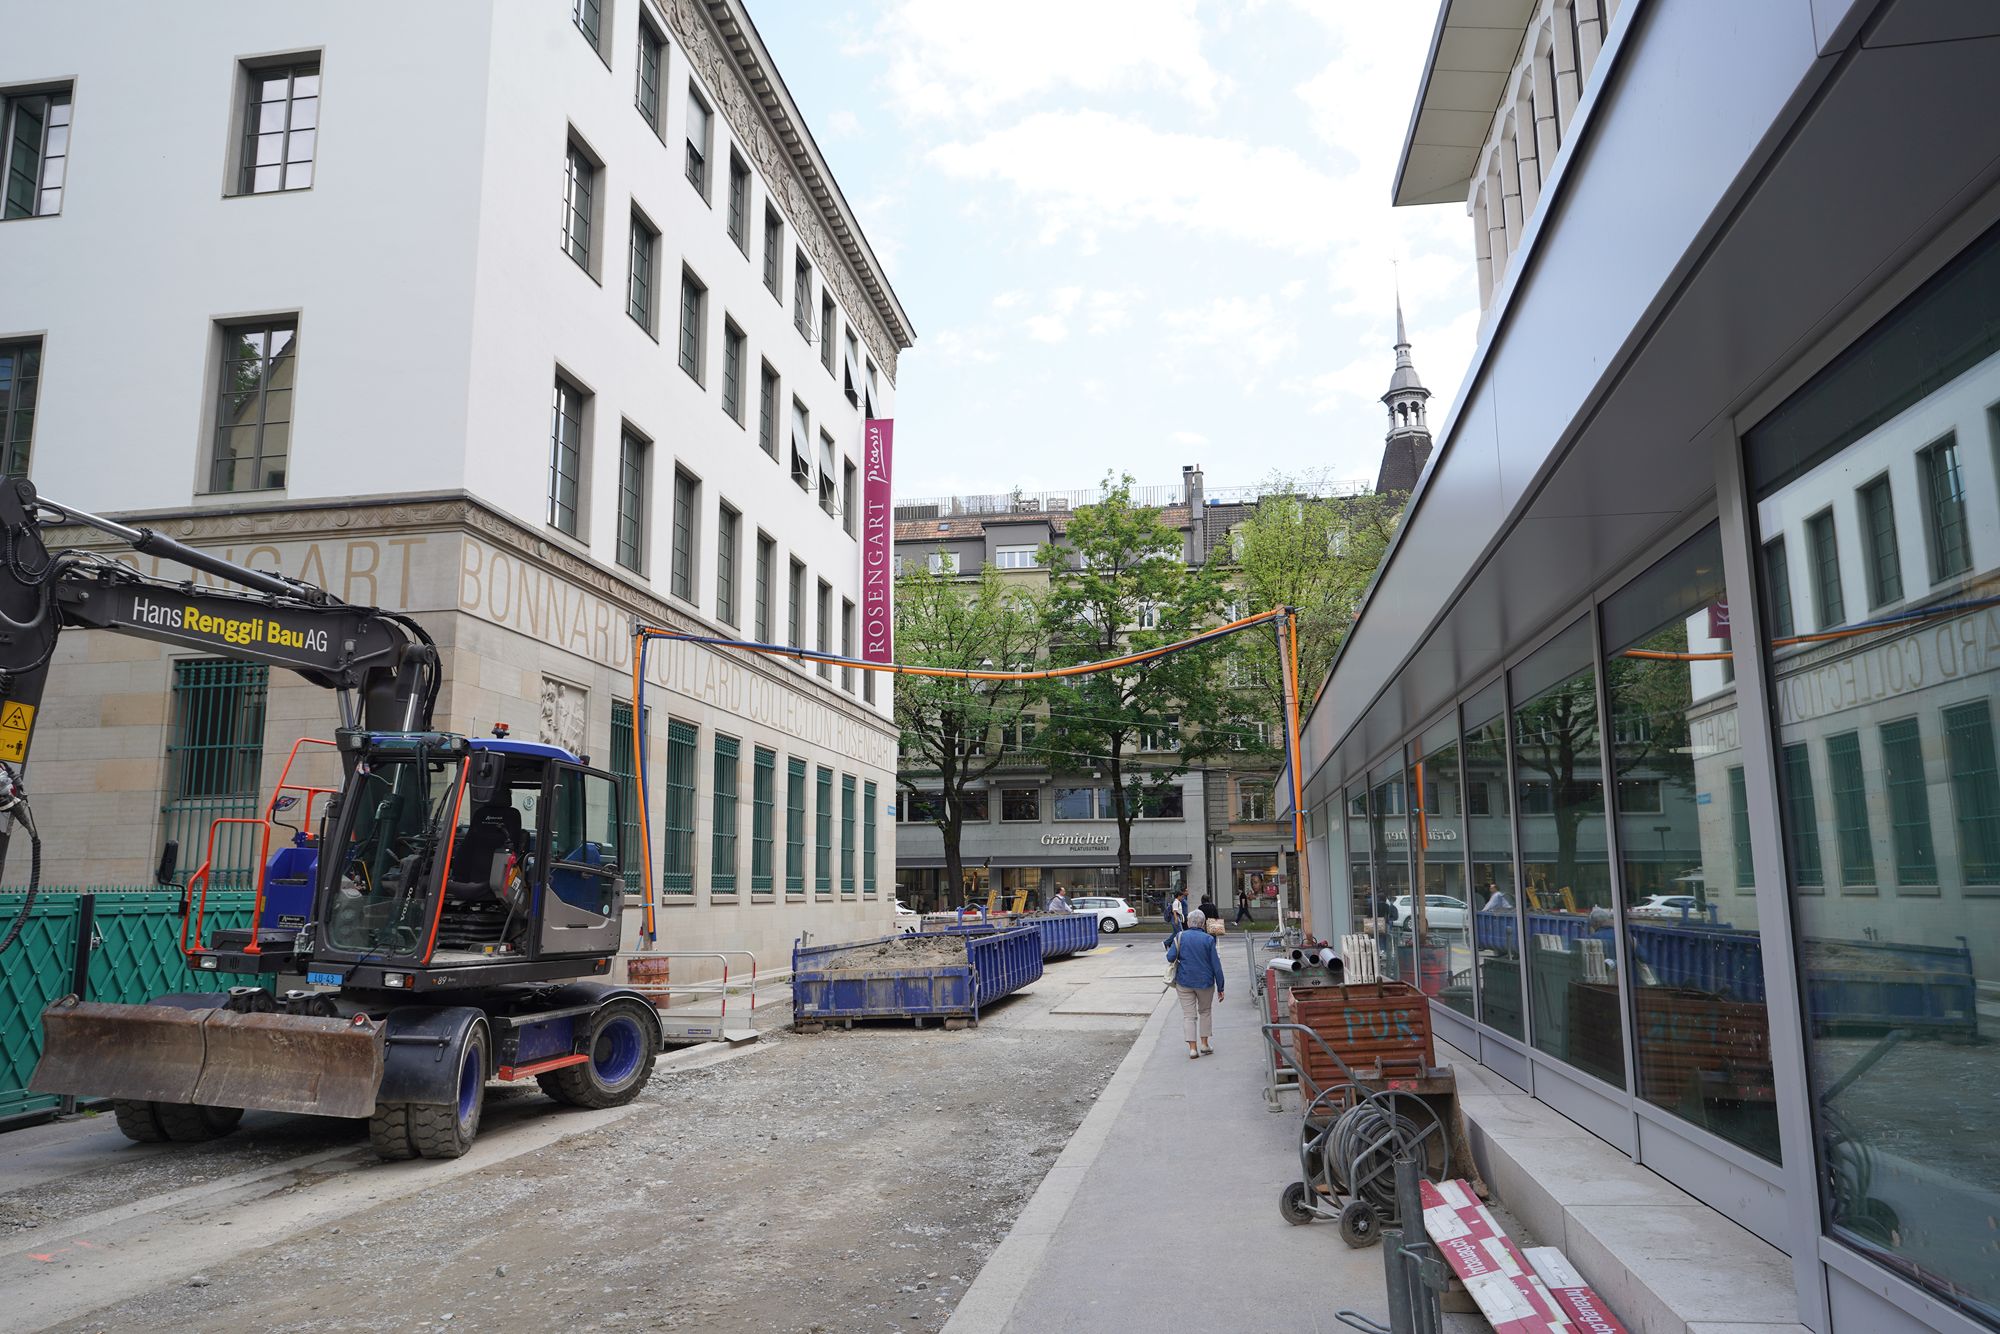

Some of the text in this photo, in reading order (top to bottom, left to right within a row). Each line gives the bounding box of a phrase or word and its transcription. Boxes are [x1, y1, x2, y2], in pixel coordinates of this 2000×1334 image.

[867, 427, 889, 654] ROSENGART Picasso
[133, 597, 328, 653] Hans Renggli Bau AG
[459, 537, 630, 668] BONNARD
[749, 673, 833, 748] COLLECTION
[836, 715, 895, 771] ROSENGART
[1040, 833, 1110, 845] Gränicher
[400, 887, 414, 921] VOLVO
[1343, 1006, 1420, 1045] PUR
